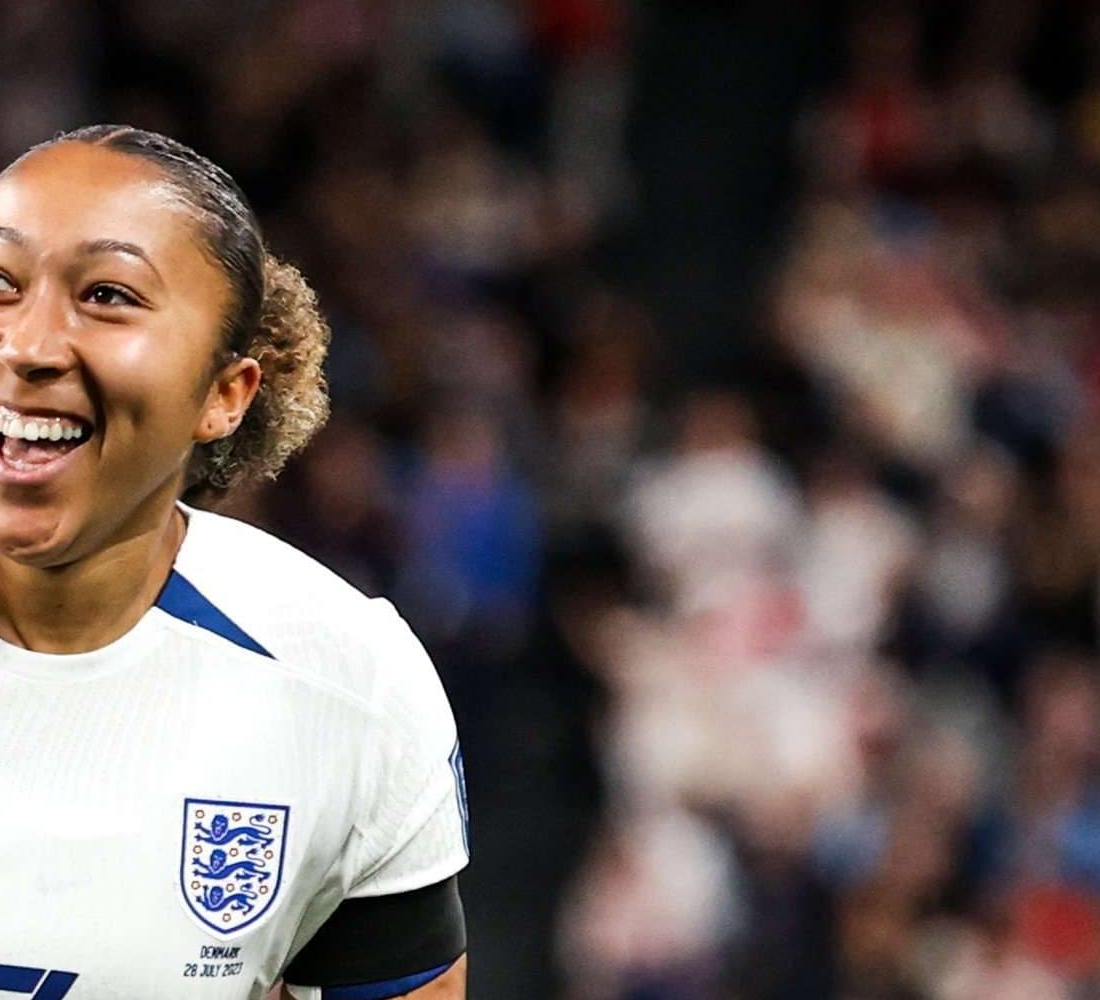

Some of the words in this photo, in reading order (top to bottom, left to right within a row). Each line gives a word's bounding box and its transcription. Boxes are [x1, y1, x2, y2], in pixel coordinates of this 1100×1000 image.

[200, 945, 241, 959] DENMARK
[183, 963, 198, 977] 28
[199, 963, 221, 977] JULY
